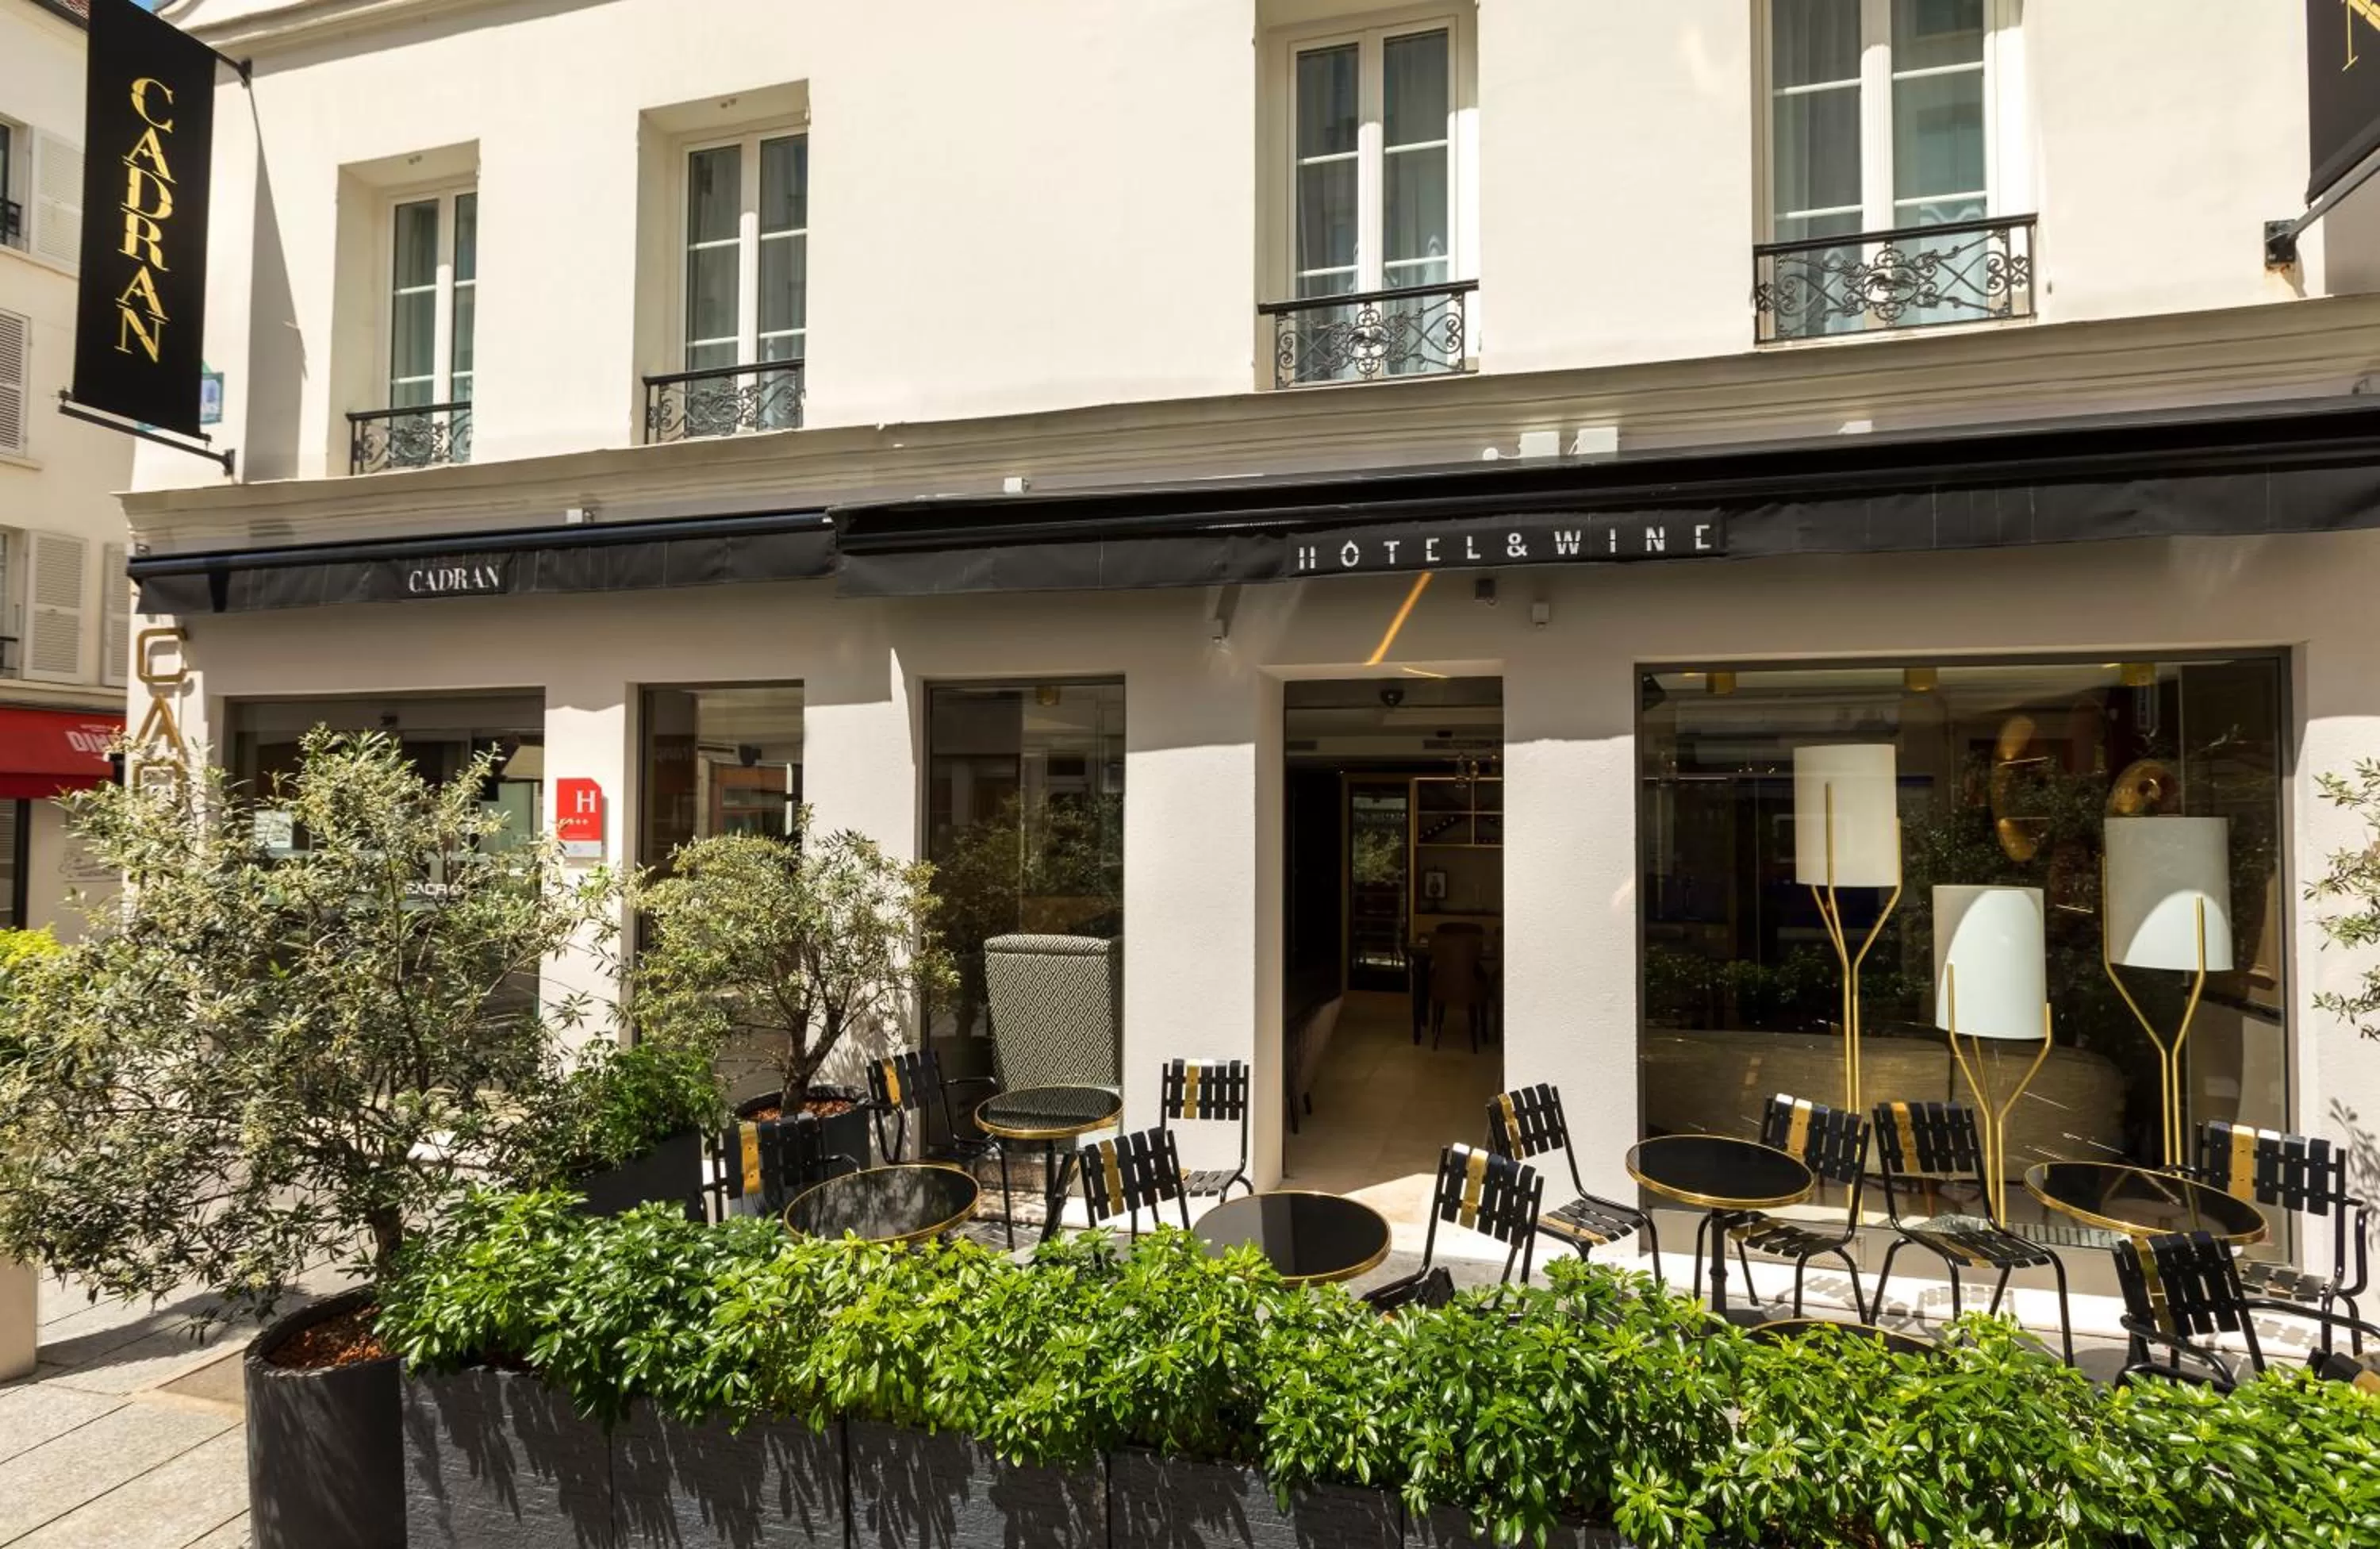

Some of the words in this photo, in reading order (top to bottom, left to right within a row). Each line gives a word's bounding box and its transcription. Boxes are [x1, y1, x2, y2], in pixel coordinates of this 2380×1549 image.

[114, 77, 178, 363] CADRAN
[1507, 532, 1528, 557] &
[1554, 525, 1711, 555] WINE
[408, 564, 501, 593] CADRAN
[576, 790, 597, 813] H
